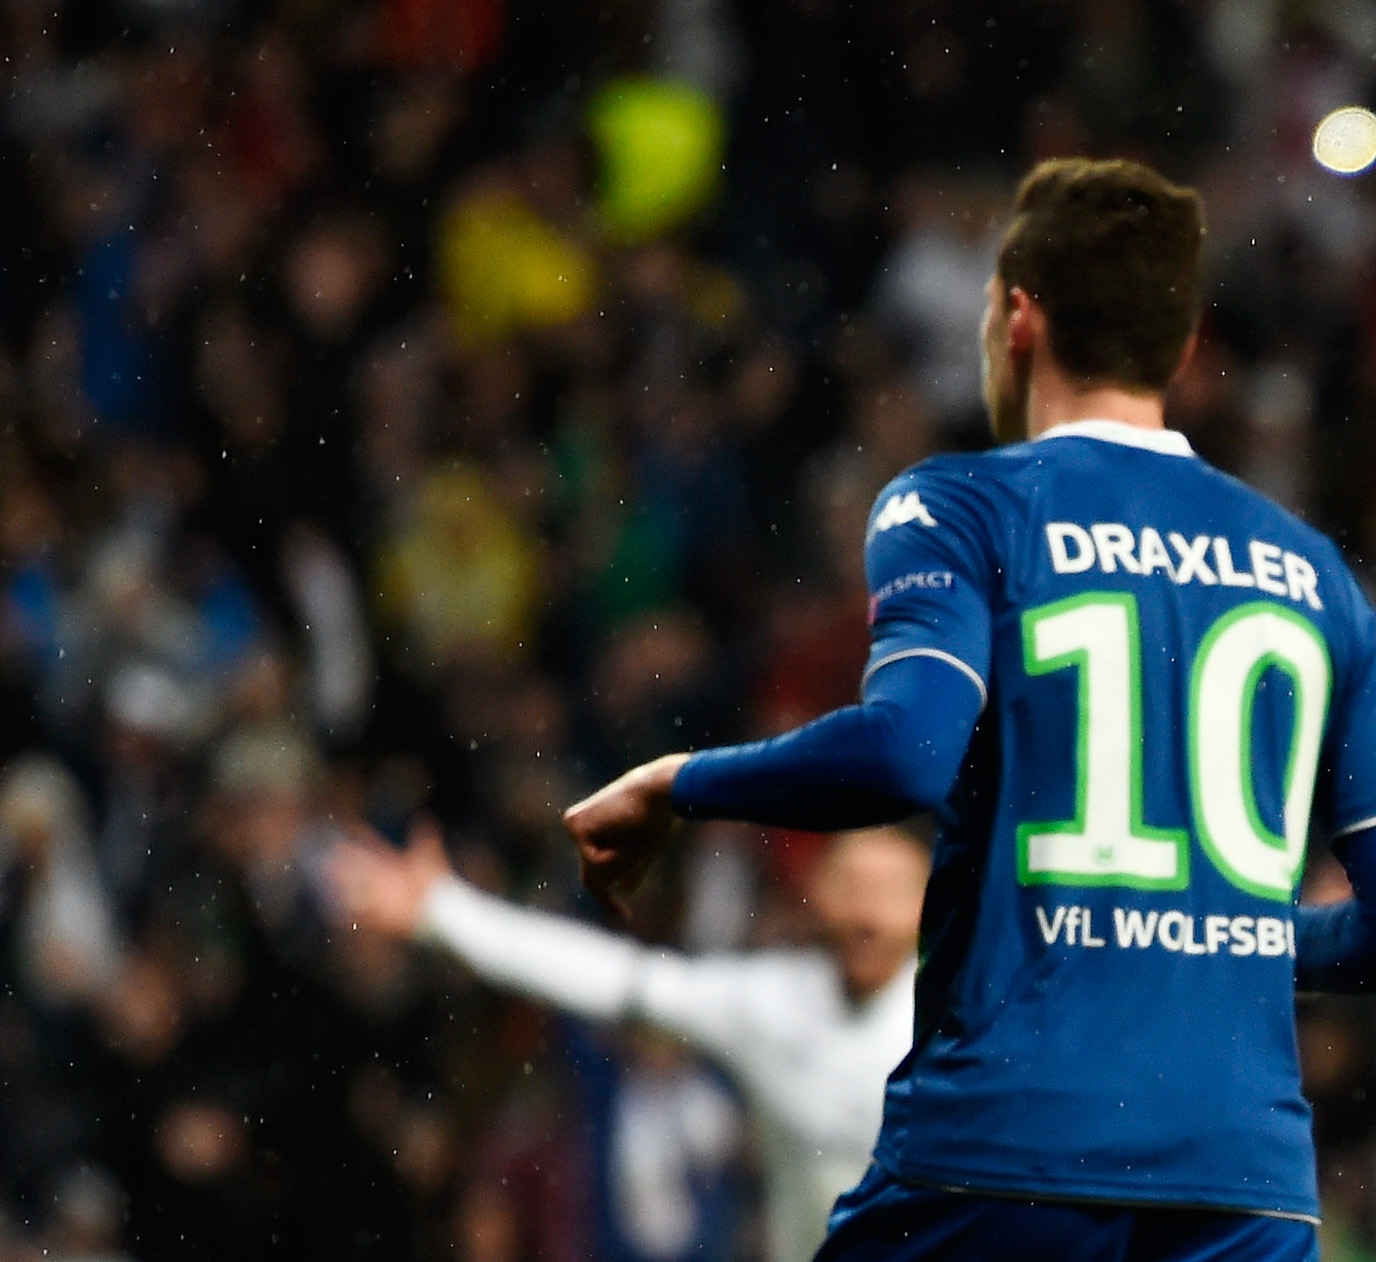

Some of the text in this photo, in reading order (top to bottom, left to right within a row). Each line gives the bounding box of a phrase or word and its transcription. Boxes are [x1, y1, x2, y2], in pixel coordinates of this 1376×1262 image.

[1046, 521, 1324, 611] DRAXLER
[1016, 590, 1333, 901] 10
[1035, 905, 1106, 948] VfL
